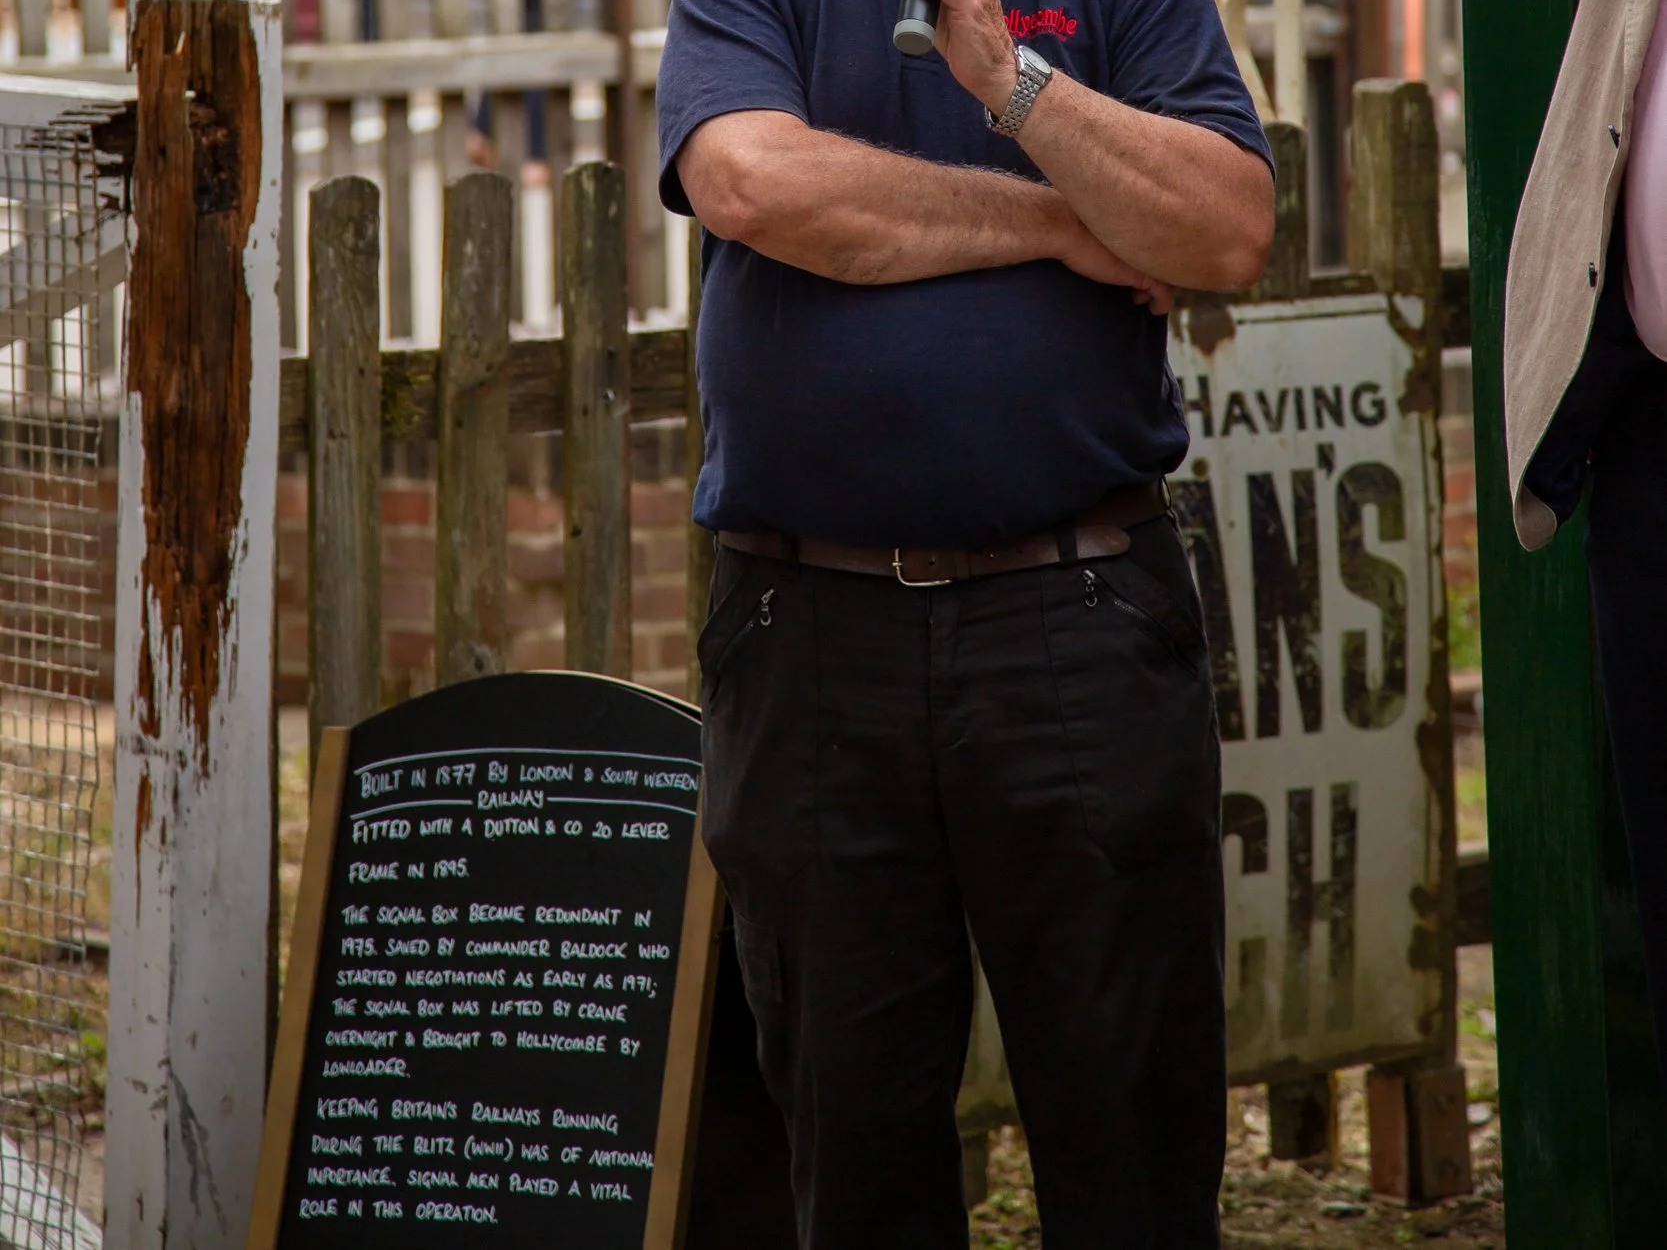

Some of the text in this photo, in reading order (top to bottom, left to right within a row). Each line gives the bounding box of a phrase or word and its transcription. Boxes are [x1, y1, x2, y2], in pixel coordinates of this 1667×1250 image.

[1177, 374, 1387, 438] HAVING
[360, 760, 700, 798] BUILT IN 1877 BY LONDON & SOUTH WESTERN
[477, 789, 545, 810] RAILWAY
[352, 816, 670, 844] FITTED WITH A DUTTON & CO 20 LEVER
[348, 861, 400, 883] FRAME
[407, 862, 425, 879] IN
[341, 902, 652, 928] THE SIGNAL BOX BECAME REDUNDANT IN
[384, 937, 431, 957] SAVED
[437, 936, 456, 956] BY
[465, 938, 551, 957] COMMANDER
[560, 940, 628, 959] BALDOCK
[638, 943, 670, 959] WHO
[336, 968, 398, 987] STARTED
[405, 968, 506, 986] NEGOTIATIONS
[512, 970, 534, 988] AS
[542, 969, 587, 989] EARLY
[592, 972, 614, 990] AS
[332, 997, 628, 1023] THE SIGNAL BOX WAS LIFTED BY CRANE
[325, 1029, 398, 1048] OVERNIGHT
[404, 1031, 416, 1046] &
[422, 1028, 482, 1050] BROUGHT
[490, 1030, 508, 1047] TO
[619, 1037, 641, 1057] BY
[317, 1097, 619, 1135] KEEPING BRITAIN'S RAILWAYS RUNNING
[311, 1134, 655, 1168] DURING THE BLITZ (WWII) WAS OF NATIONAL
[406, 1169, 459, 1190] SIGNAL
[466, 1171, 500, 1189] MEN
[508, 1172, 560, 1196] PLAYED
[567, 1179, 581, 1197] A
[590, 1182, 633, 1201] VITAL
[299, 1198, 498, 1223] ROLE IN THIS OPERATION.
